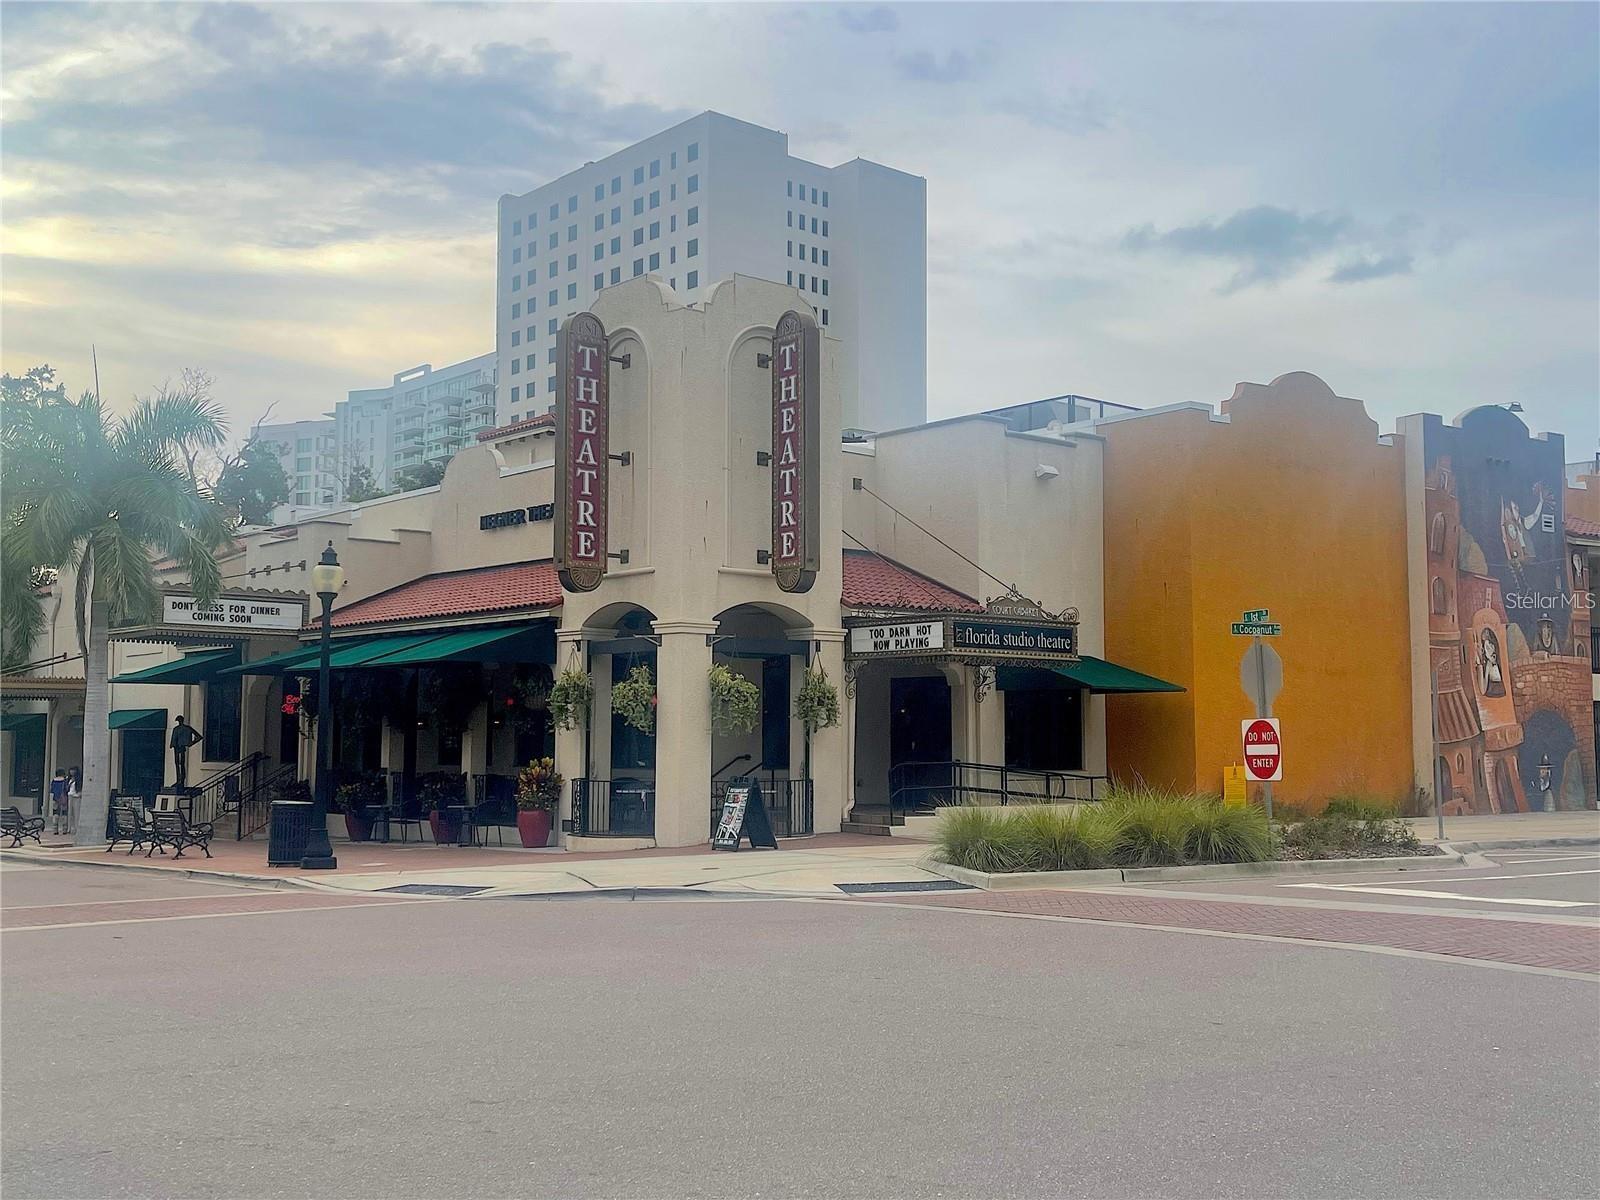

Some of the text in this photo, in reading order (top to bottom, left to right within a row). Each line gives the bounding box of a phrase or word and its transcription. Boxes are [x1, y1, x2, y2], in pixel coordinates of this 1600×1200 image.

[576, 345, 599, 557] THEATRE
[779, 344, 797, 558] THEATRE
[171, 601, 195, 610] DONT
[229, 604, 246, 614] FOR
[250, 606, 281, 615] DINNER
[192, 612, 252, 624] COMING SOON
[869, 624, 932, 639] TOO DARN HOT
[1239, 624, 1273, 635] Cocoanut
[873, 637, 930, 651] NOW PLAYING
[965, 627, 1000, 646] florida
[1002, 631, 1035, 648] studio
[1037, 632, 1071, 650] theatre
[1248, 731, 1275, 742] DO NOT
[1252, 758, 1274, 768] ENTER
